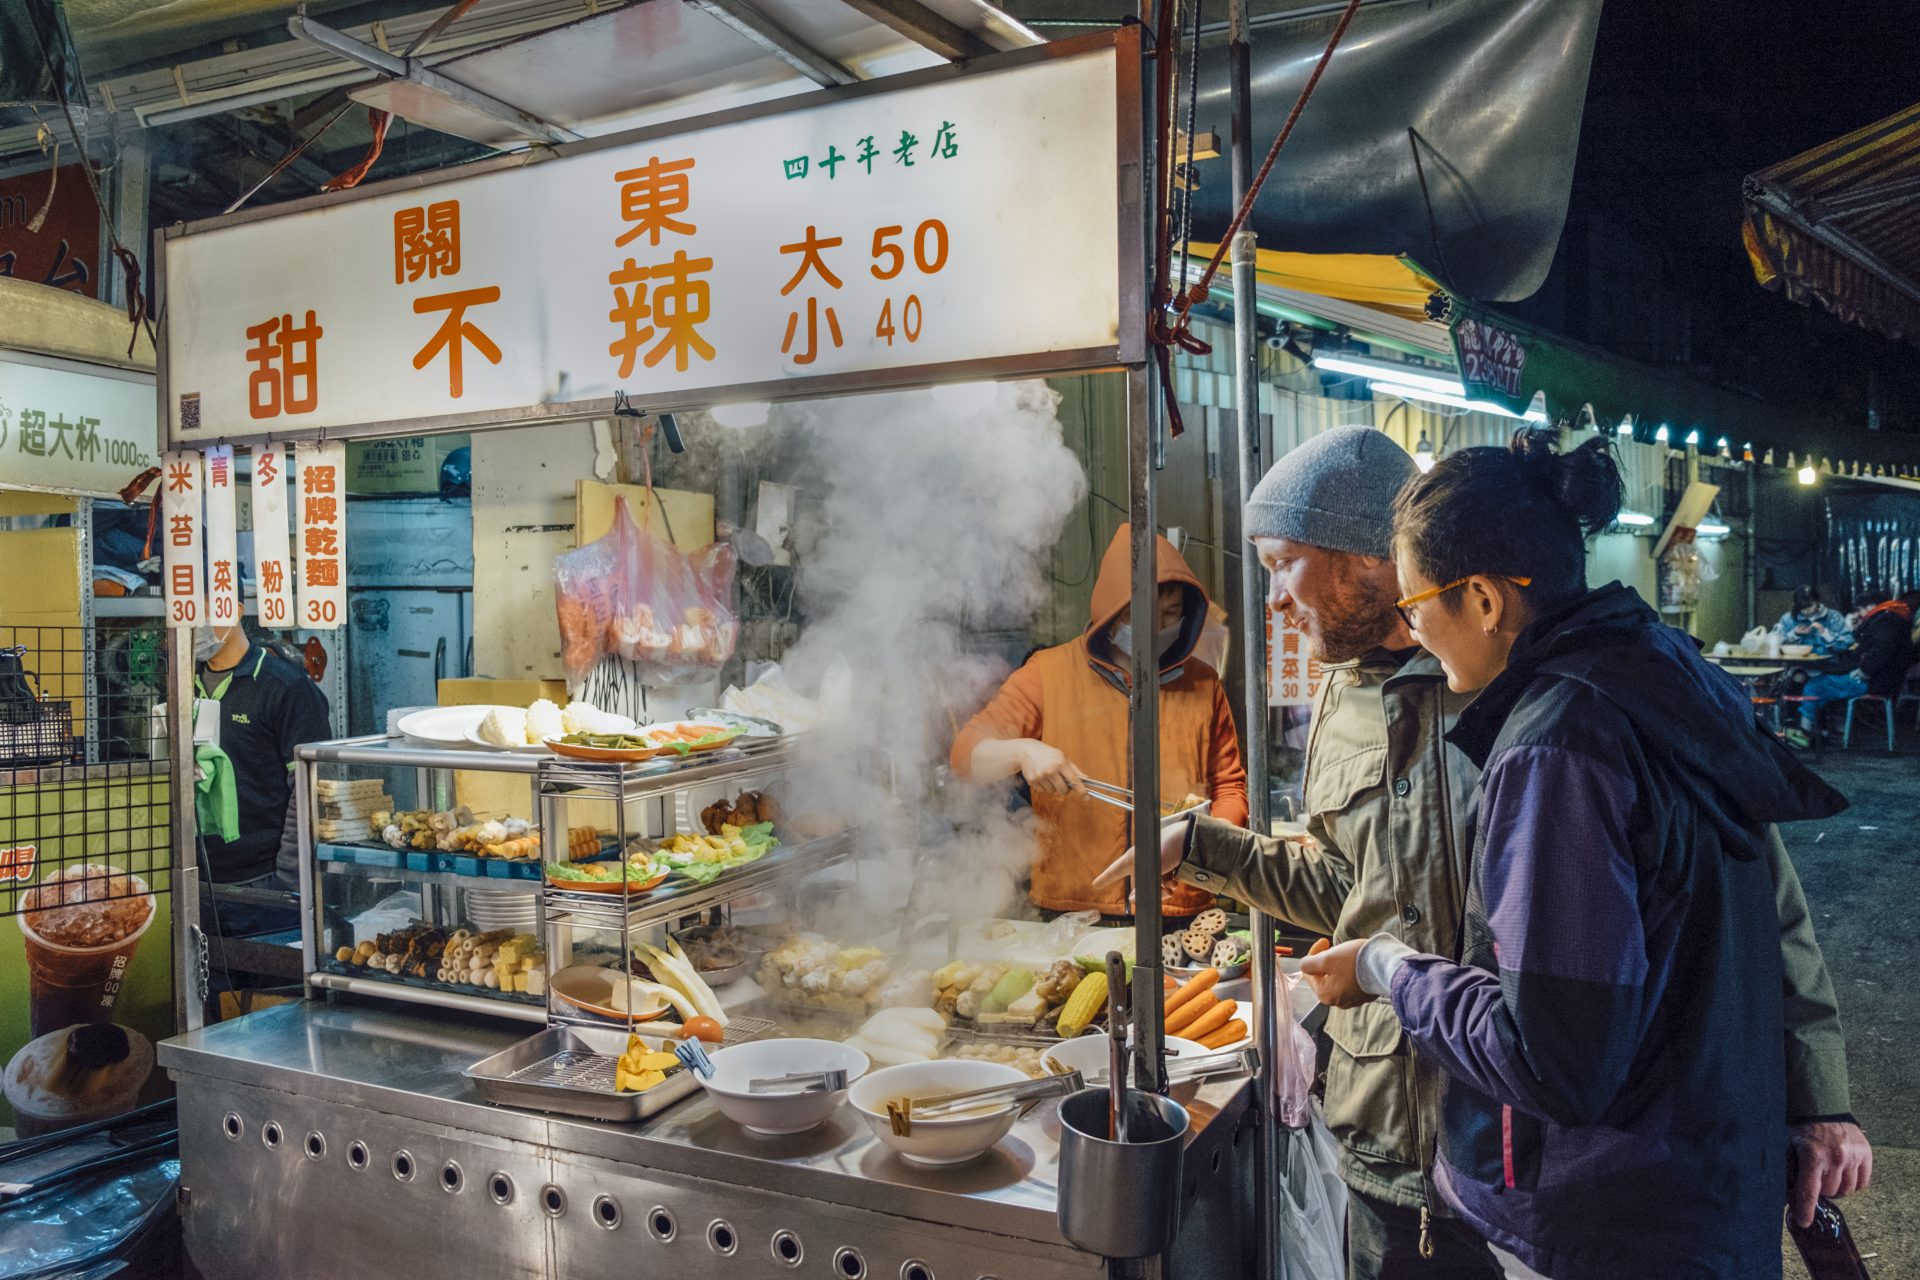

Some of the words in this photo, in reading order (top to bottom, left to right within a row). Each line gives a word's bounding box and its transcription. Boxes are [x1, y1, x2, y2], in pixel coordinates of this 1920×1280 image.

[783, 121, 959, 181] 四十年老店
[780, 226, 843, 297] 大
[870, 218, 949, 281] 50
[780, 297, 843, 365] 小
[876, 294, 922, 347] 40
[19, 408, 101, 463] 超大杯
[104, 438, 150, 467] 1000cc
[169, 461, 194, 596] 米苔目
[211, 456, 232, 592] 青菜
[258, 453, 284, 594] 冬粉
[304, 465, 339, 587] 招牌乾麵
[173, 600, 196, 622] 30
[215, 597, 232, 619] 30
[264, 598, 285, 621] 30
[307, 600, 337, 623] 30
[1282, 683, 1299, 698] 30
